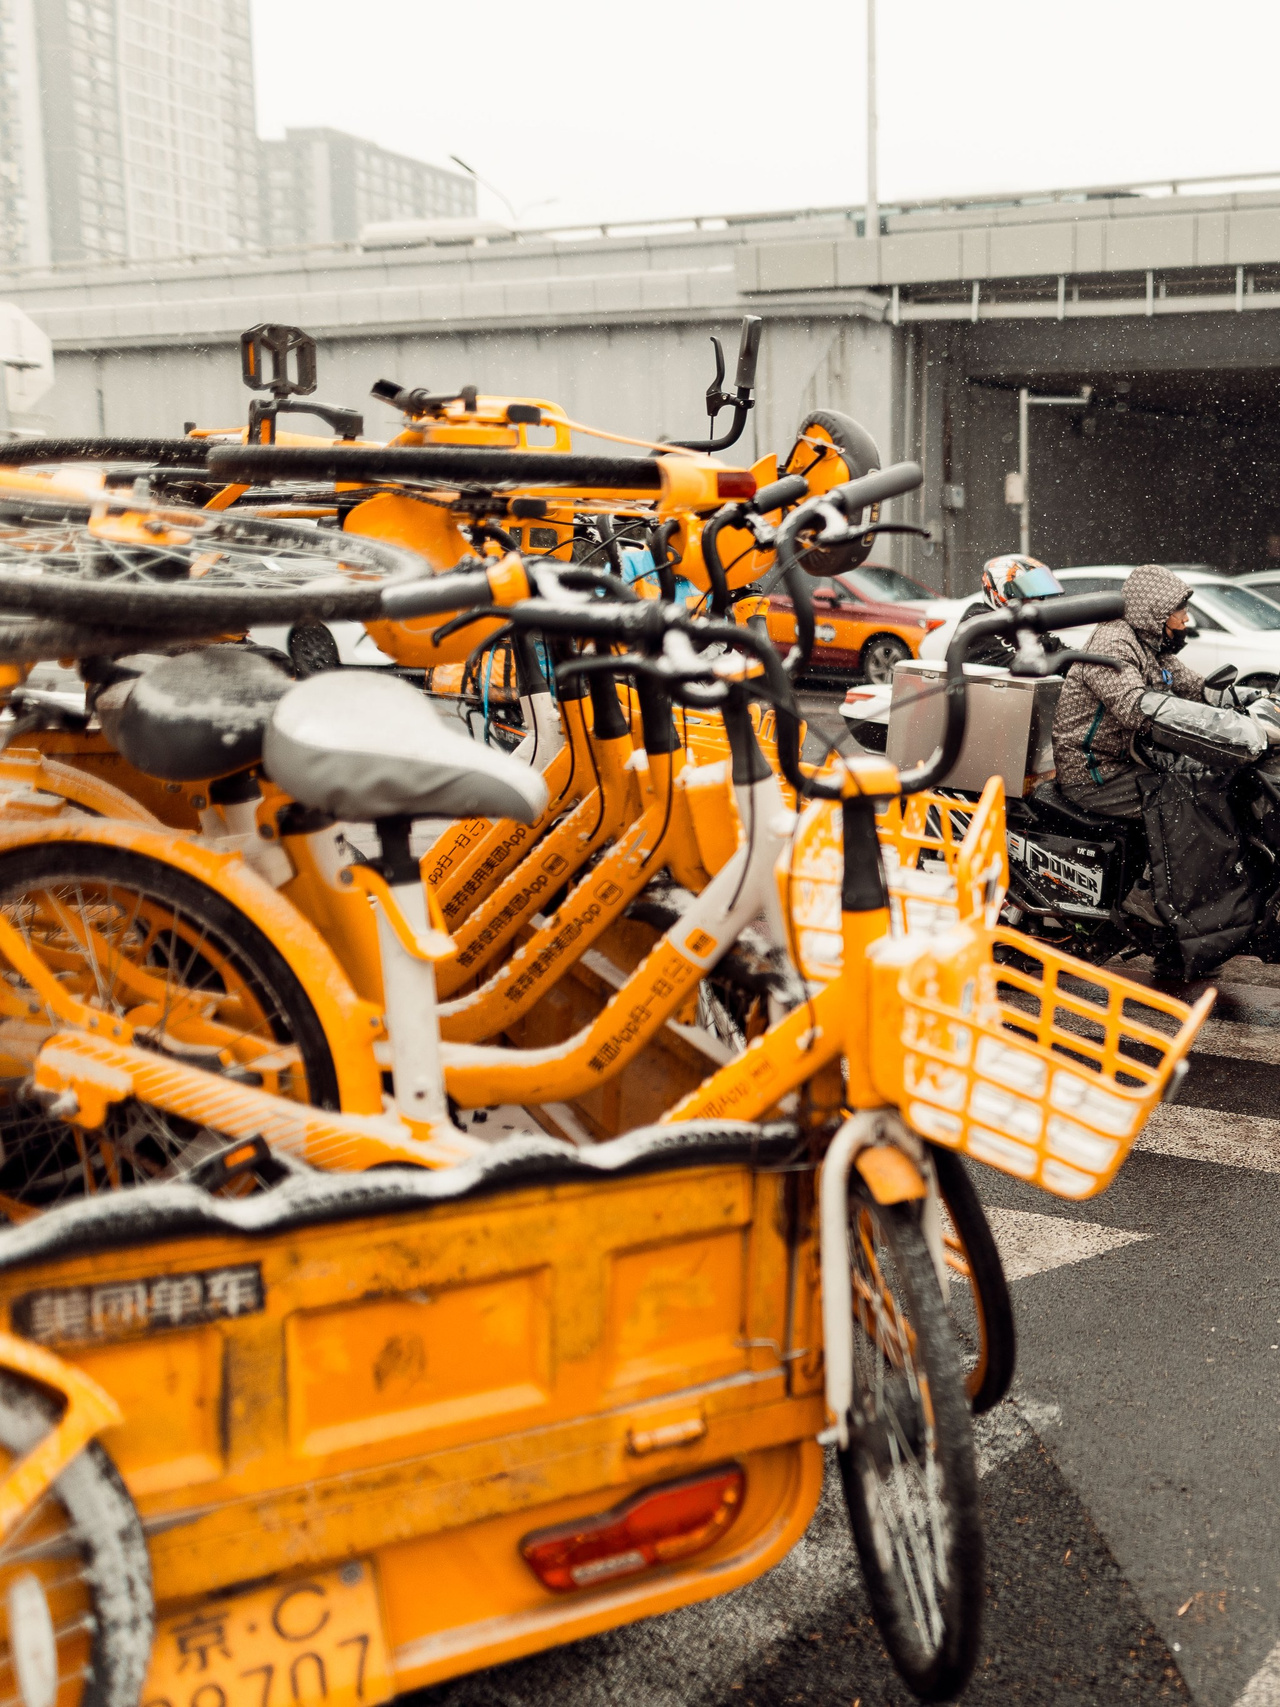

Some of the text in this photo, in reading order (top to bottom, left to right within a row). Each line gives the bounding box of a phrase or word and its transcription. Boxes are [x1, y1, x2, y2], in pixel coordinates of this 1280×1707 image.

[442, 827, 527, 918] 推荐使用美团App
[1029, 847, 1099, 894] POWER
[456, 874, 549, 968] 推荐使用美团App
[31, 1268, 258, 1342] 美团单车
[142, 1633, 369, 1707] 707
